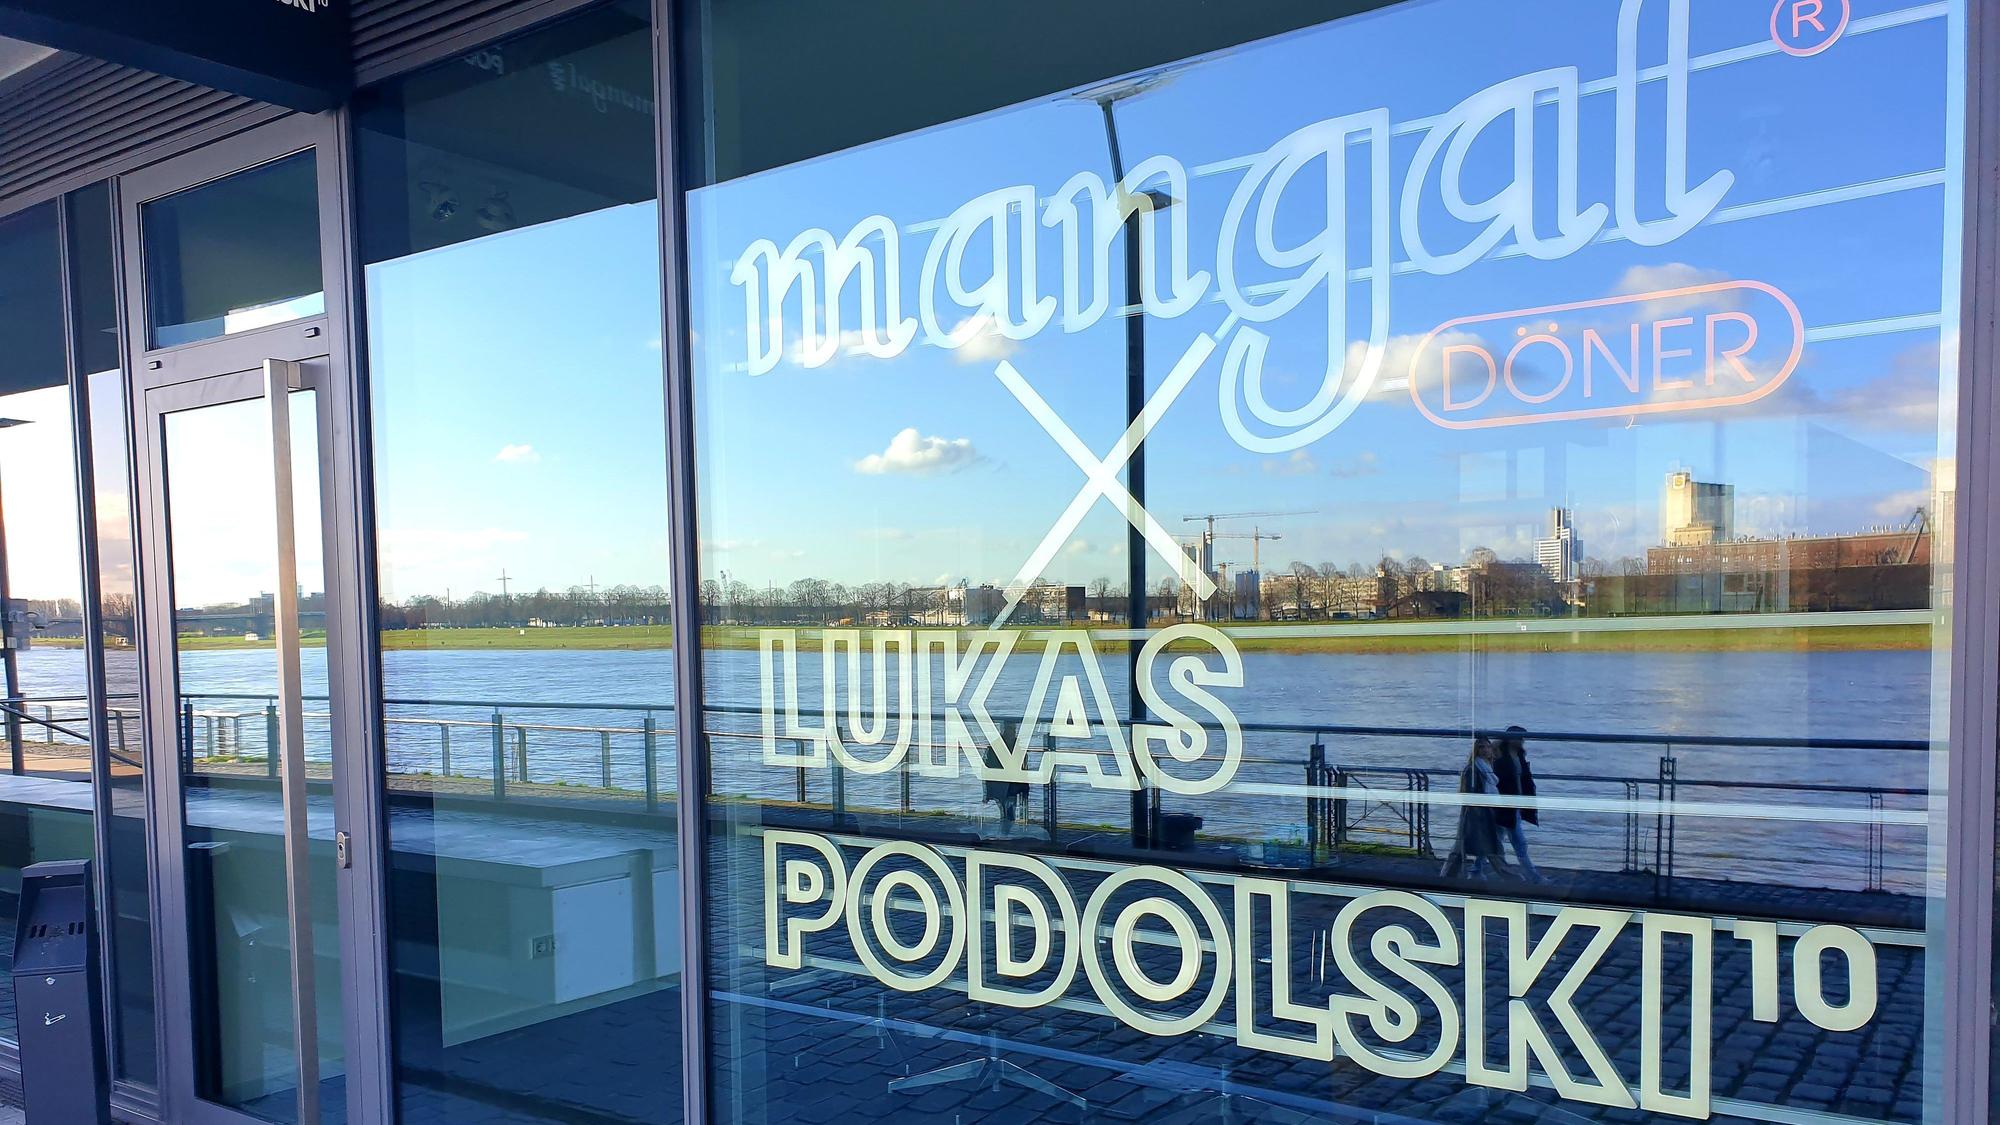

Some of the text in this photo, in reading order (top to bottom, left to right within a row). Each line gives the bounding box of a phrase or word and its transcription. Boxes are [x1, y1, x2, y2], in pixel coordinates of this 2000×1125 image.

[730, 0, 1735, 453] mangal
[1441, 311, 1758, 411] DÖNER
[759, 624, 1244, 793] LUKAS
[763, 830, 1712, 1120] PODOLSKI
